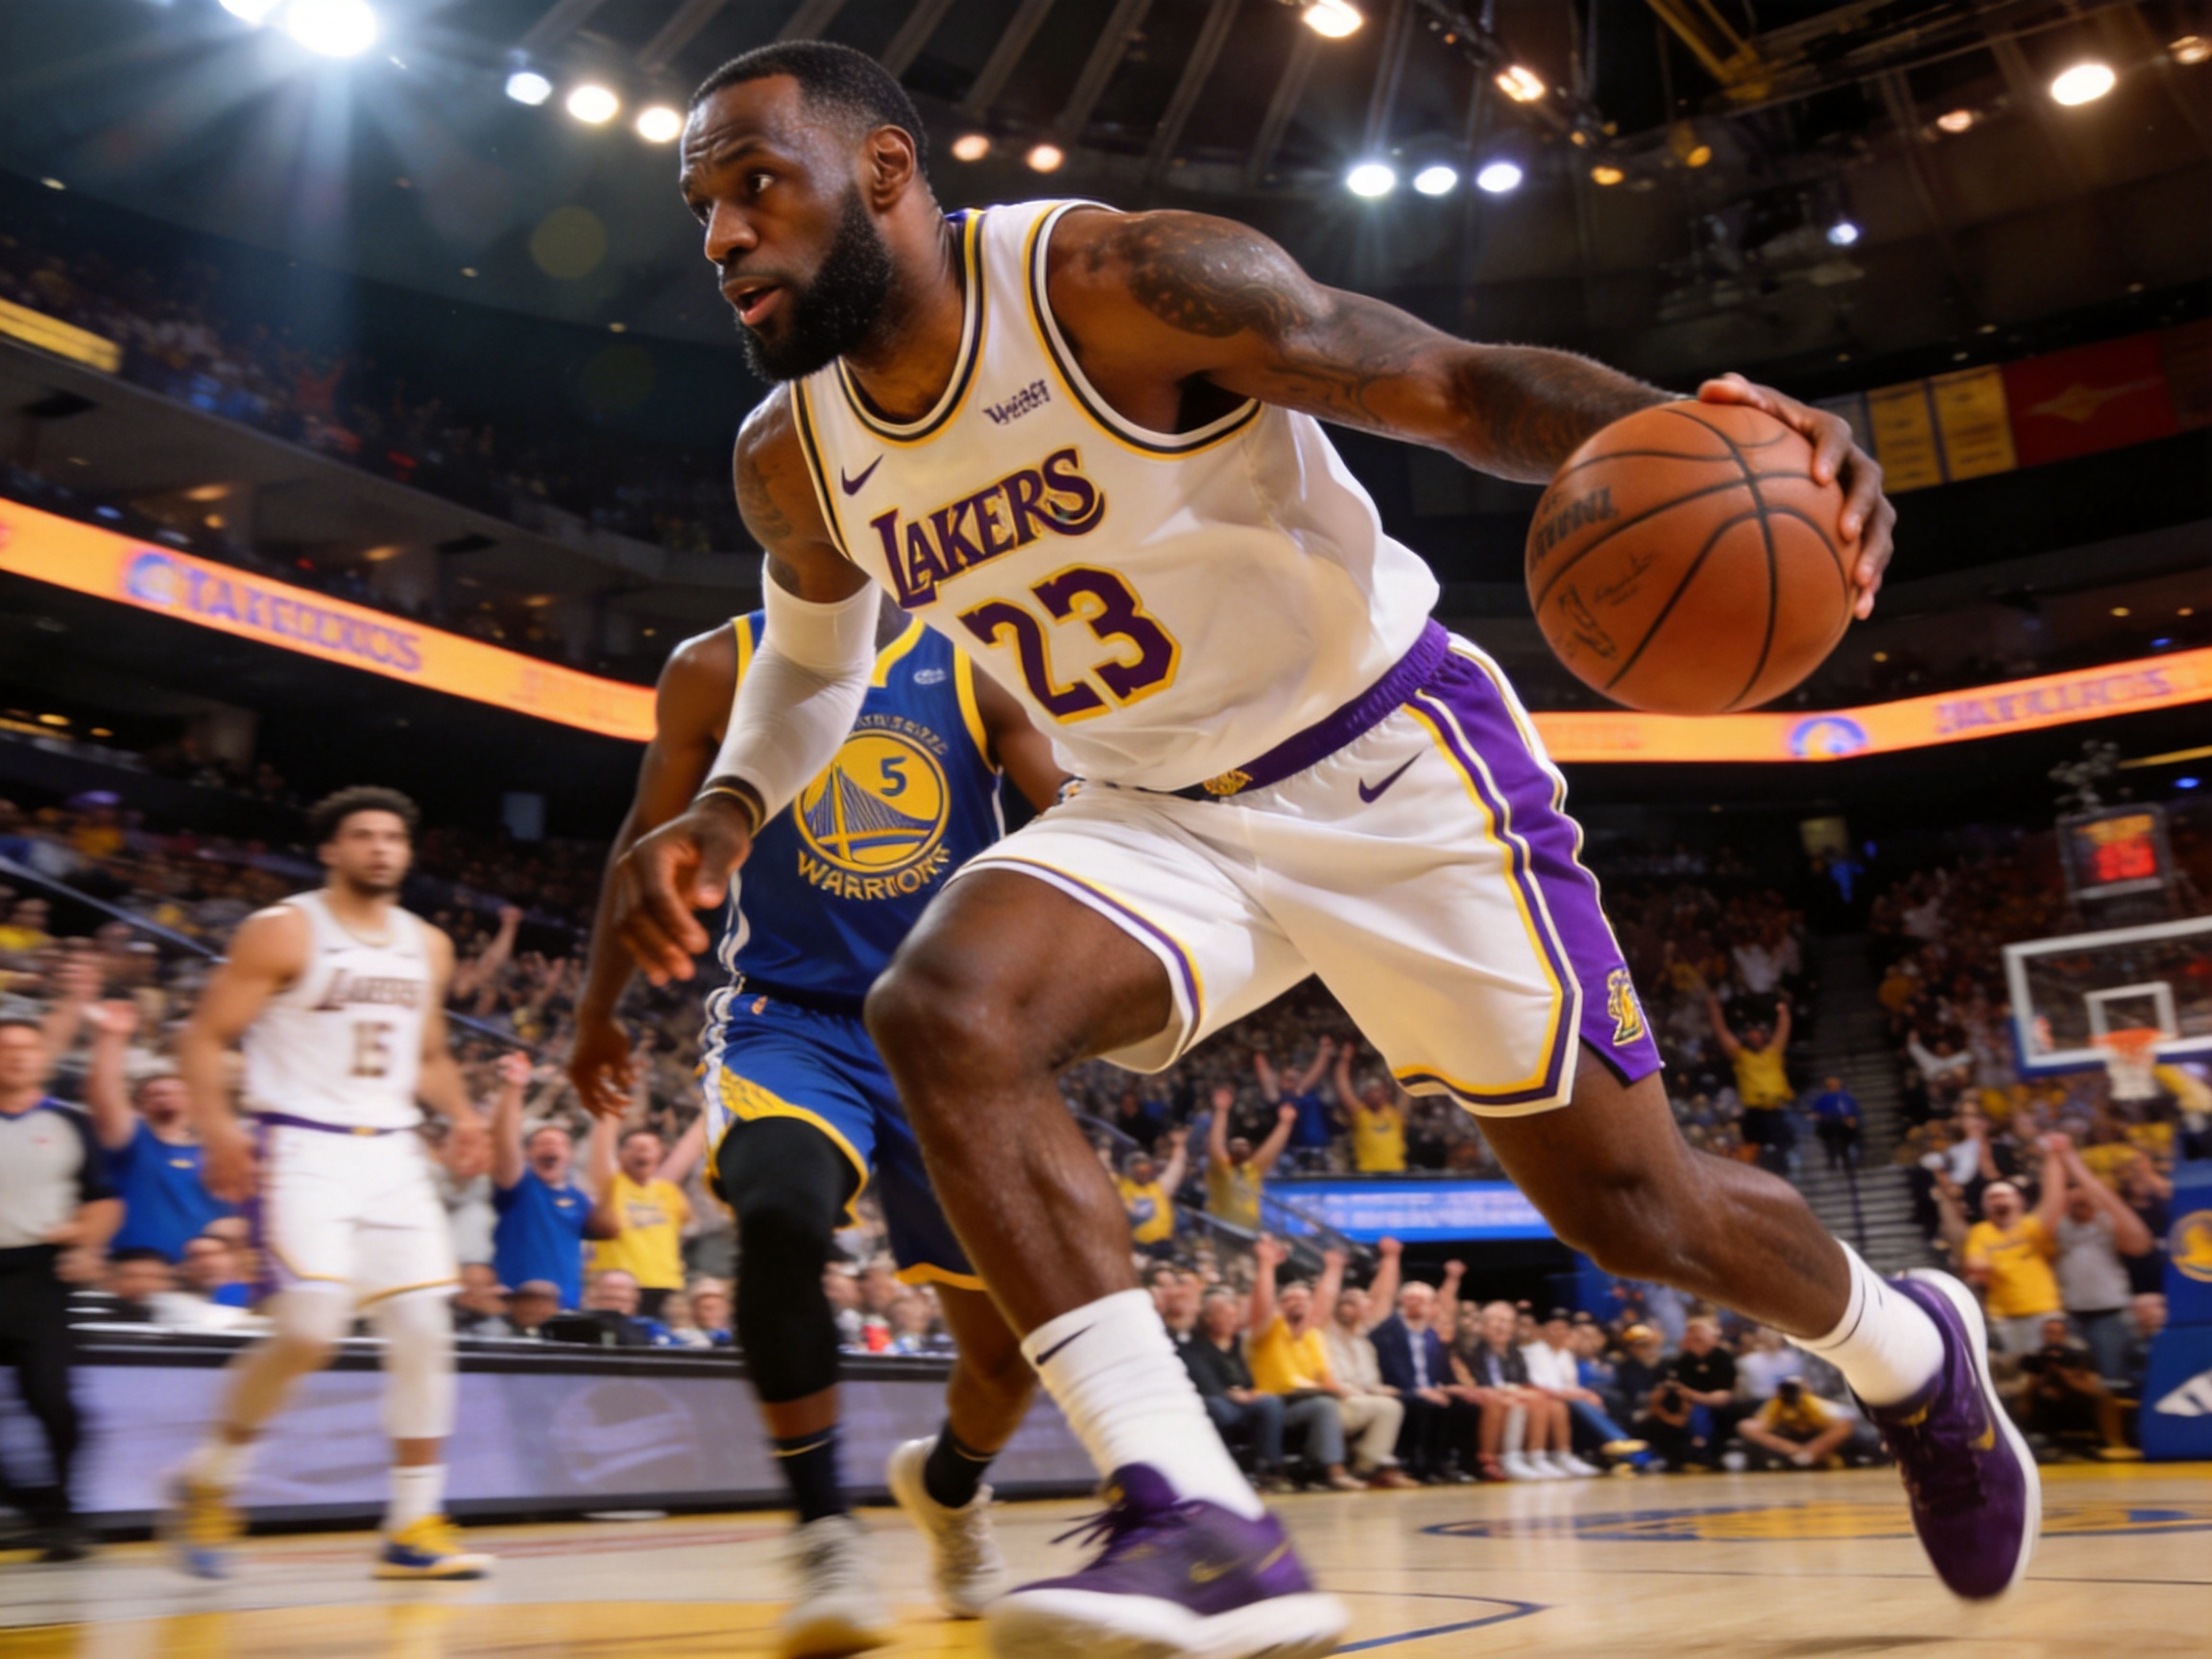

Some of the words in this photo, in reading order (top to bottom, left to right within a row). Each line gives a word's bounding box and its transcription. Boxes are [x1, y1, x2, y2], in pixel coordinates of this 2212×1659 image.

[869, 445, 1108, 610] LAKERS
[956, 563, 1182, 725] 23
[878, 756, 907, 797] 5
